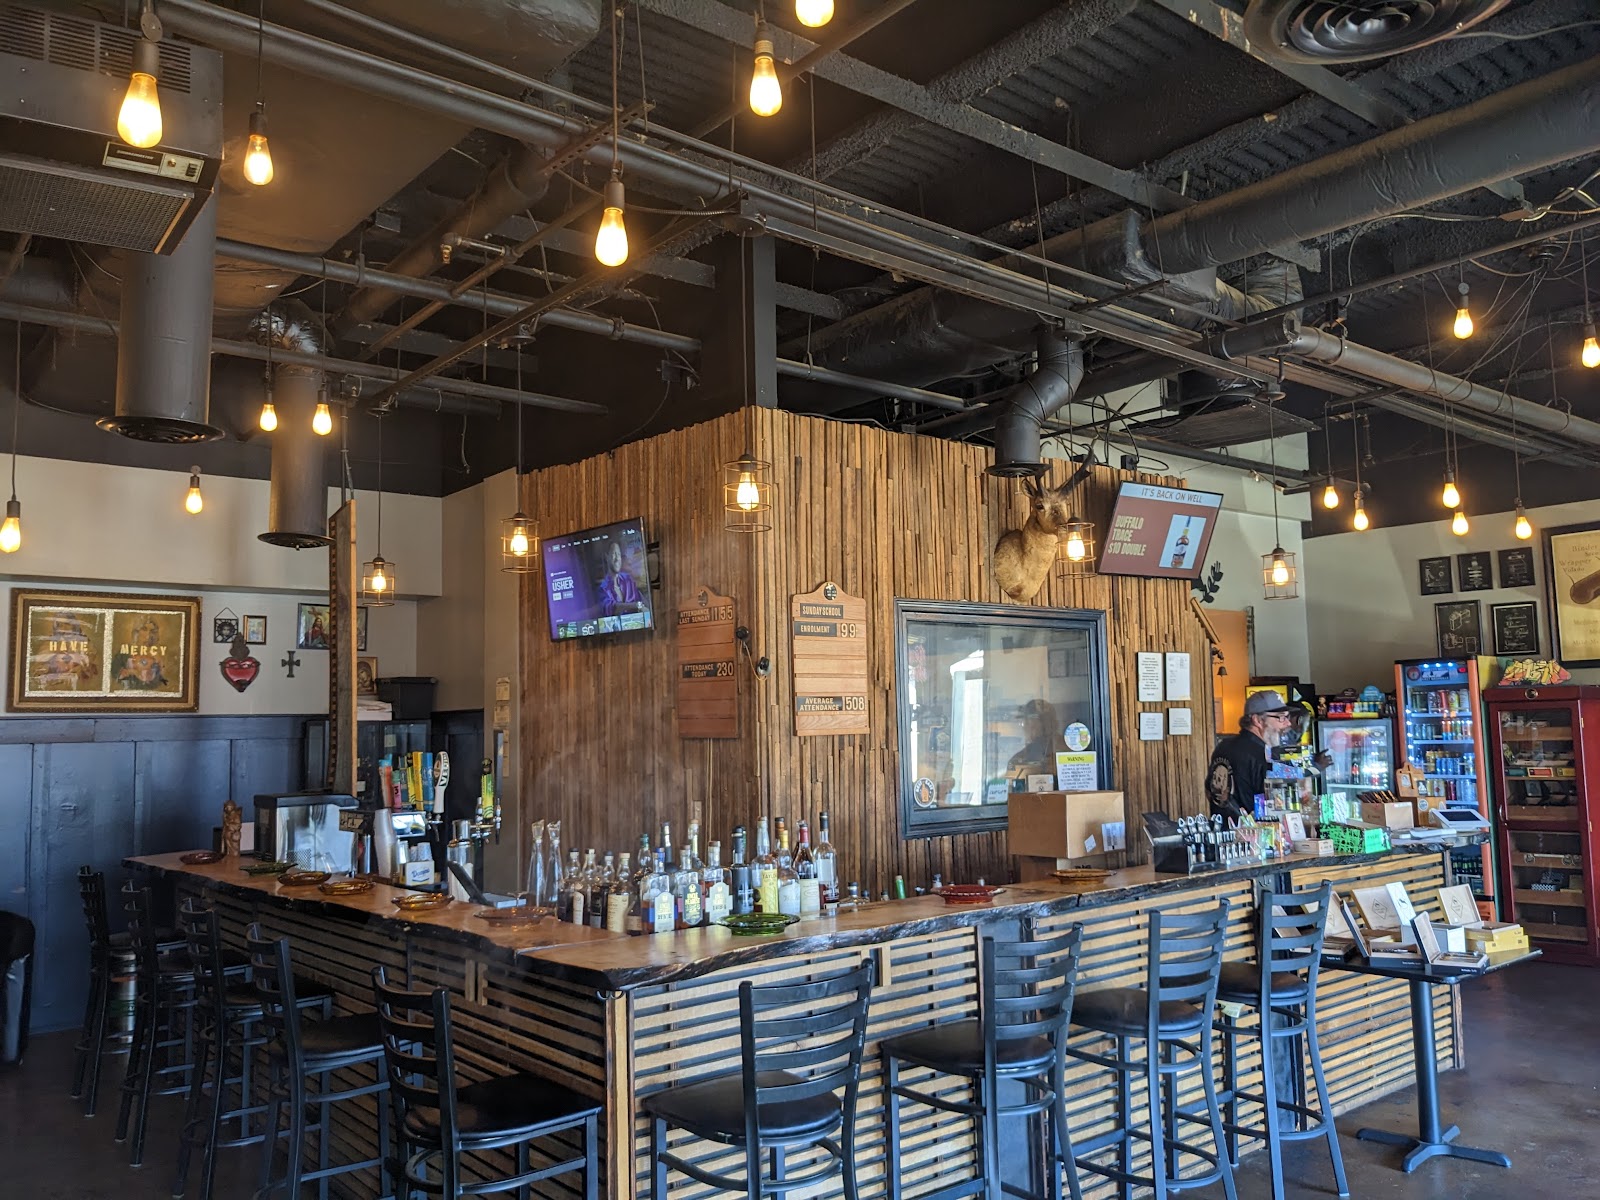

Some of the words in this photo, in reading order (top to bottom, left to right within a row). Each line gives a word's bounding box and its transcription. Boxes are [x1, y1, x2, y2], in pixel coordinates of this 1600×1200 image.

[1141, 487, 1155, 497] IT'S
[1156, 489, 1174, 499] BACK
[1175, 491, 1186, 501] ON
[1187, 493, 1203, 503] WELL
[1115, 515, 1144, 530] BUFFALO
[1112, 528, 1134, 543] TRACE
[1107, 542, 1121, 555] $10
[1120, 543, 1147, 557] DOUBLE
[552, 580, 575, 592] USHER
[680, 608, 710, 618] ATTENDANCE
[692, 615, 711, 623] SUNDAY
[800, 624, 831, 633] ENROLMENT
[841, 623, 857, 638] 99
[49, 641, 89, 651] HAVE
[120, 643, 168, 656] MERCY
[684, 663, 714, 671] ATTENDANCE
[717, 662, 734, 677] 230
[805, 697, 834, 705] AVERAGE
